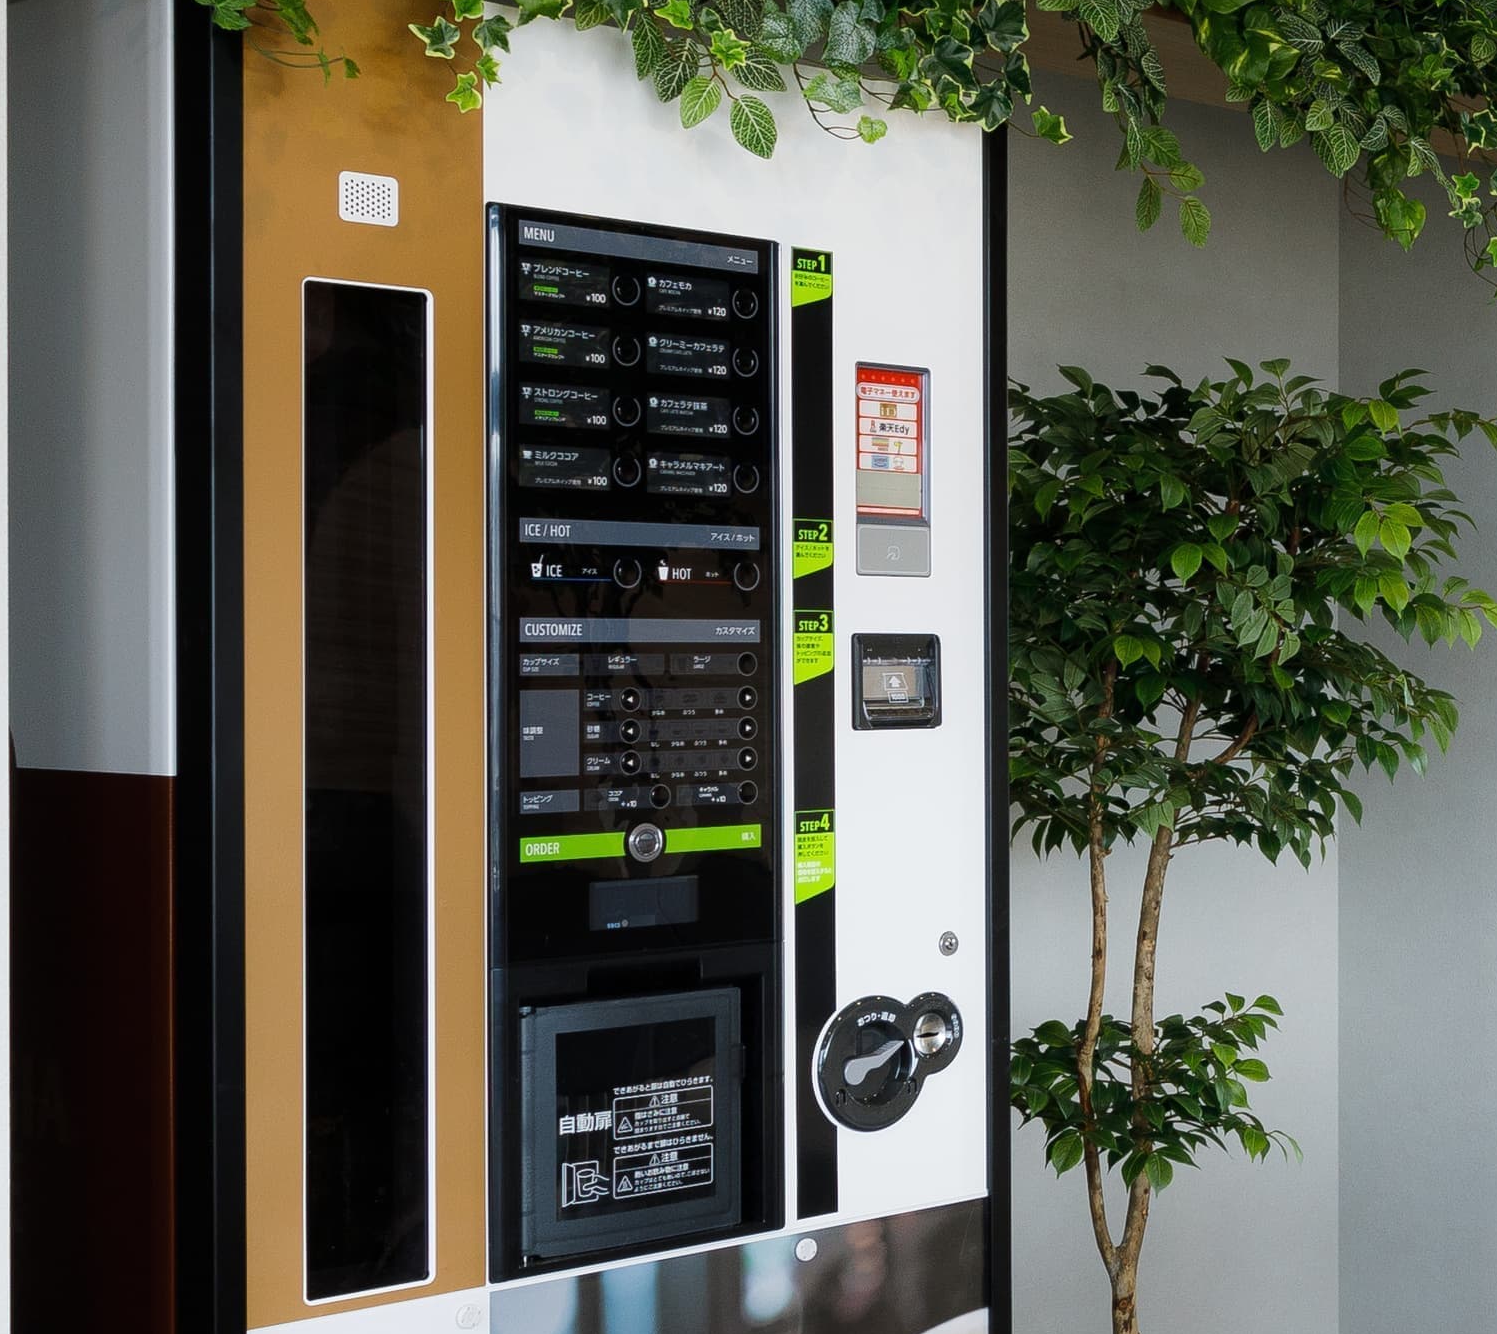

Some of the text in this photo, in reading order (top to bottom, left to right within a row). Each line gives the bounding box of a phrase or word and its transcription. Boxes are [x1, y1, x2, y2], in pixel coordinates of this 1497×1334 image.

[524, 227, 555, 243] MENU
[727, 255, 753, 265] メニュー
[533, 264, 590, 278] ブレンドコーヒー
[659, 279, 692, 291] カフェモカ
[533, 325, 595, 339] アメリカンコーヒー
[659, 338, 725, 353] クリーミーカフェラテ
[534, 387, 598, 401] ストロングコーヒー
[879, 422, 910, 435] 楽天Edy
[534, 450, 579, 461] ミルクココア
[659, 460, 725, 472] キャラメルマキアート
[524, 524, 541, 536] ICE
[550, 524, 571, 538] HOT
[546, 565, 563, 578] ICE
[672, 568, 692, 580] HOT
[524, 624, 583, 636] CUSTOMIZE
[715, 626, 755, 636] カスタマイズ
[522, 658, 560, 666] カップサイズ
[608, 655, 637, 664] レギュラー
[693, 655, 711, 663] ラージ
[587, 693, 611, 701] コーヒー
[523, 794, 553, 803] トッピング
[525, 842, 560, 856] ORDER
[660, 1093, 678, 1105] 注意
[559, 1110, 612, 1135] 自動扉
[660, 1151, 678, 1163] 注意
